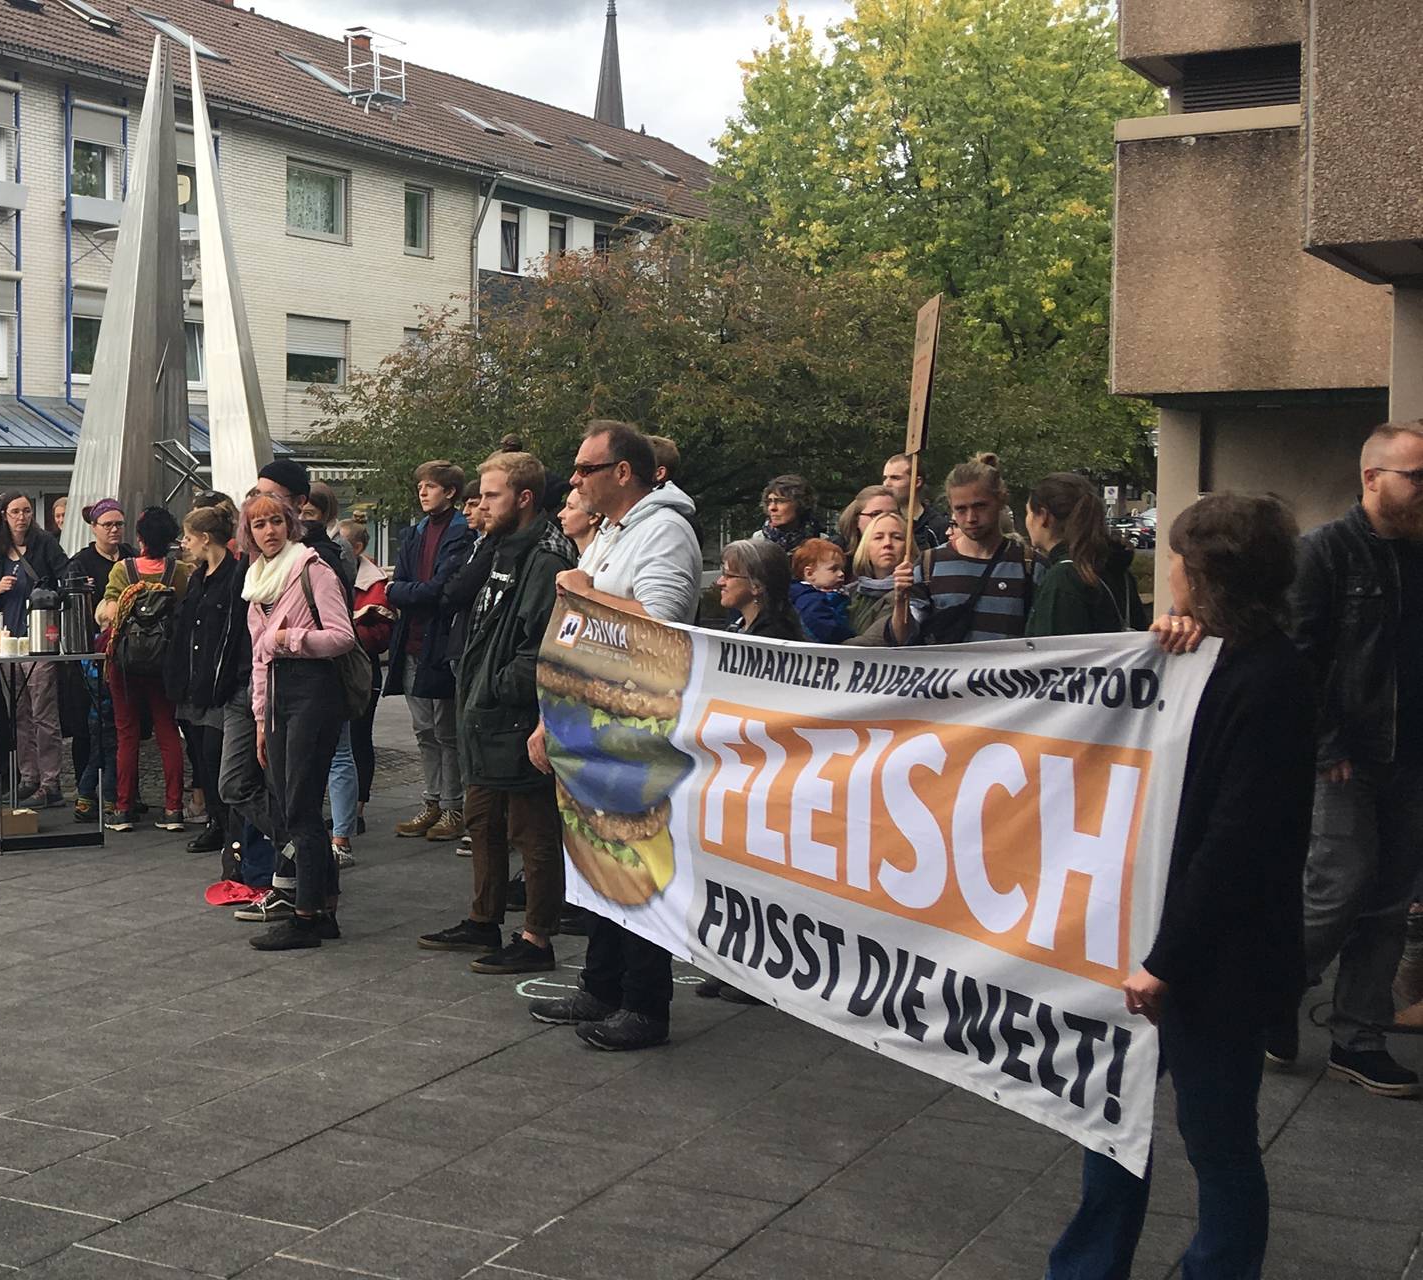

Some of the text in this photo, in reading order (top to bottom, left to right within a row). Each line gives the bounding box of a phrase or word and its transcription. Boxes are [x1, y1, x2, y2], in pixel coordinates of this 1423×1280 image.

[717, 641, 1166, 712] KLIMAKILLER. RAUBBAU. HUNGERTOD.
[700, 711, 1142, 970] FLEISCH
[697, 878, 1133, 1125] FRISST DIE WELT!
